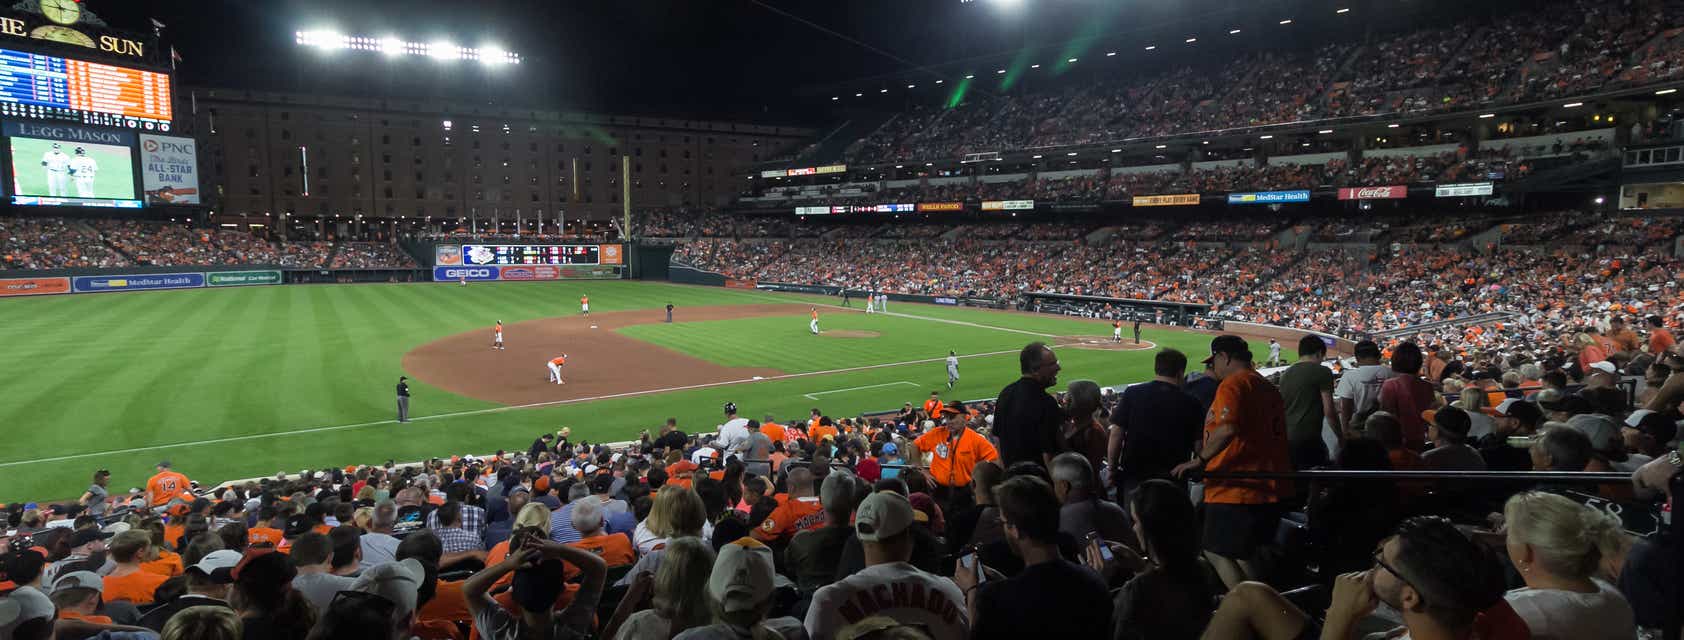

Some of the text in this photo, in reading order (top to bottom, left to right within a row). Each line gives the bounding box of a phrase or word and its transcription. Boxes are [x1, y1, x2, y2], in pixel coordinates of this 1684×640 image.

[0, 16, 143, 57] HE SUN
[18, 123, 121, 144] LEGG MASON
[161, 142, 192, 154] PNC
[148, 163, 192, 174] ALL-STAR
[158, 172, 183, 183] BANK
[1285, 192, 1308, 200] Health
[446, 269, 490, 278] GEICO
[129, 277, 191, 286] MedStar Health
